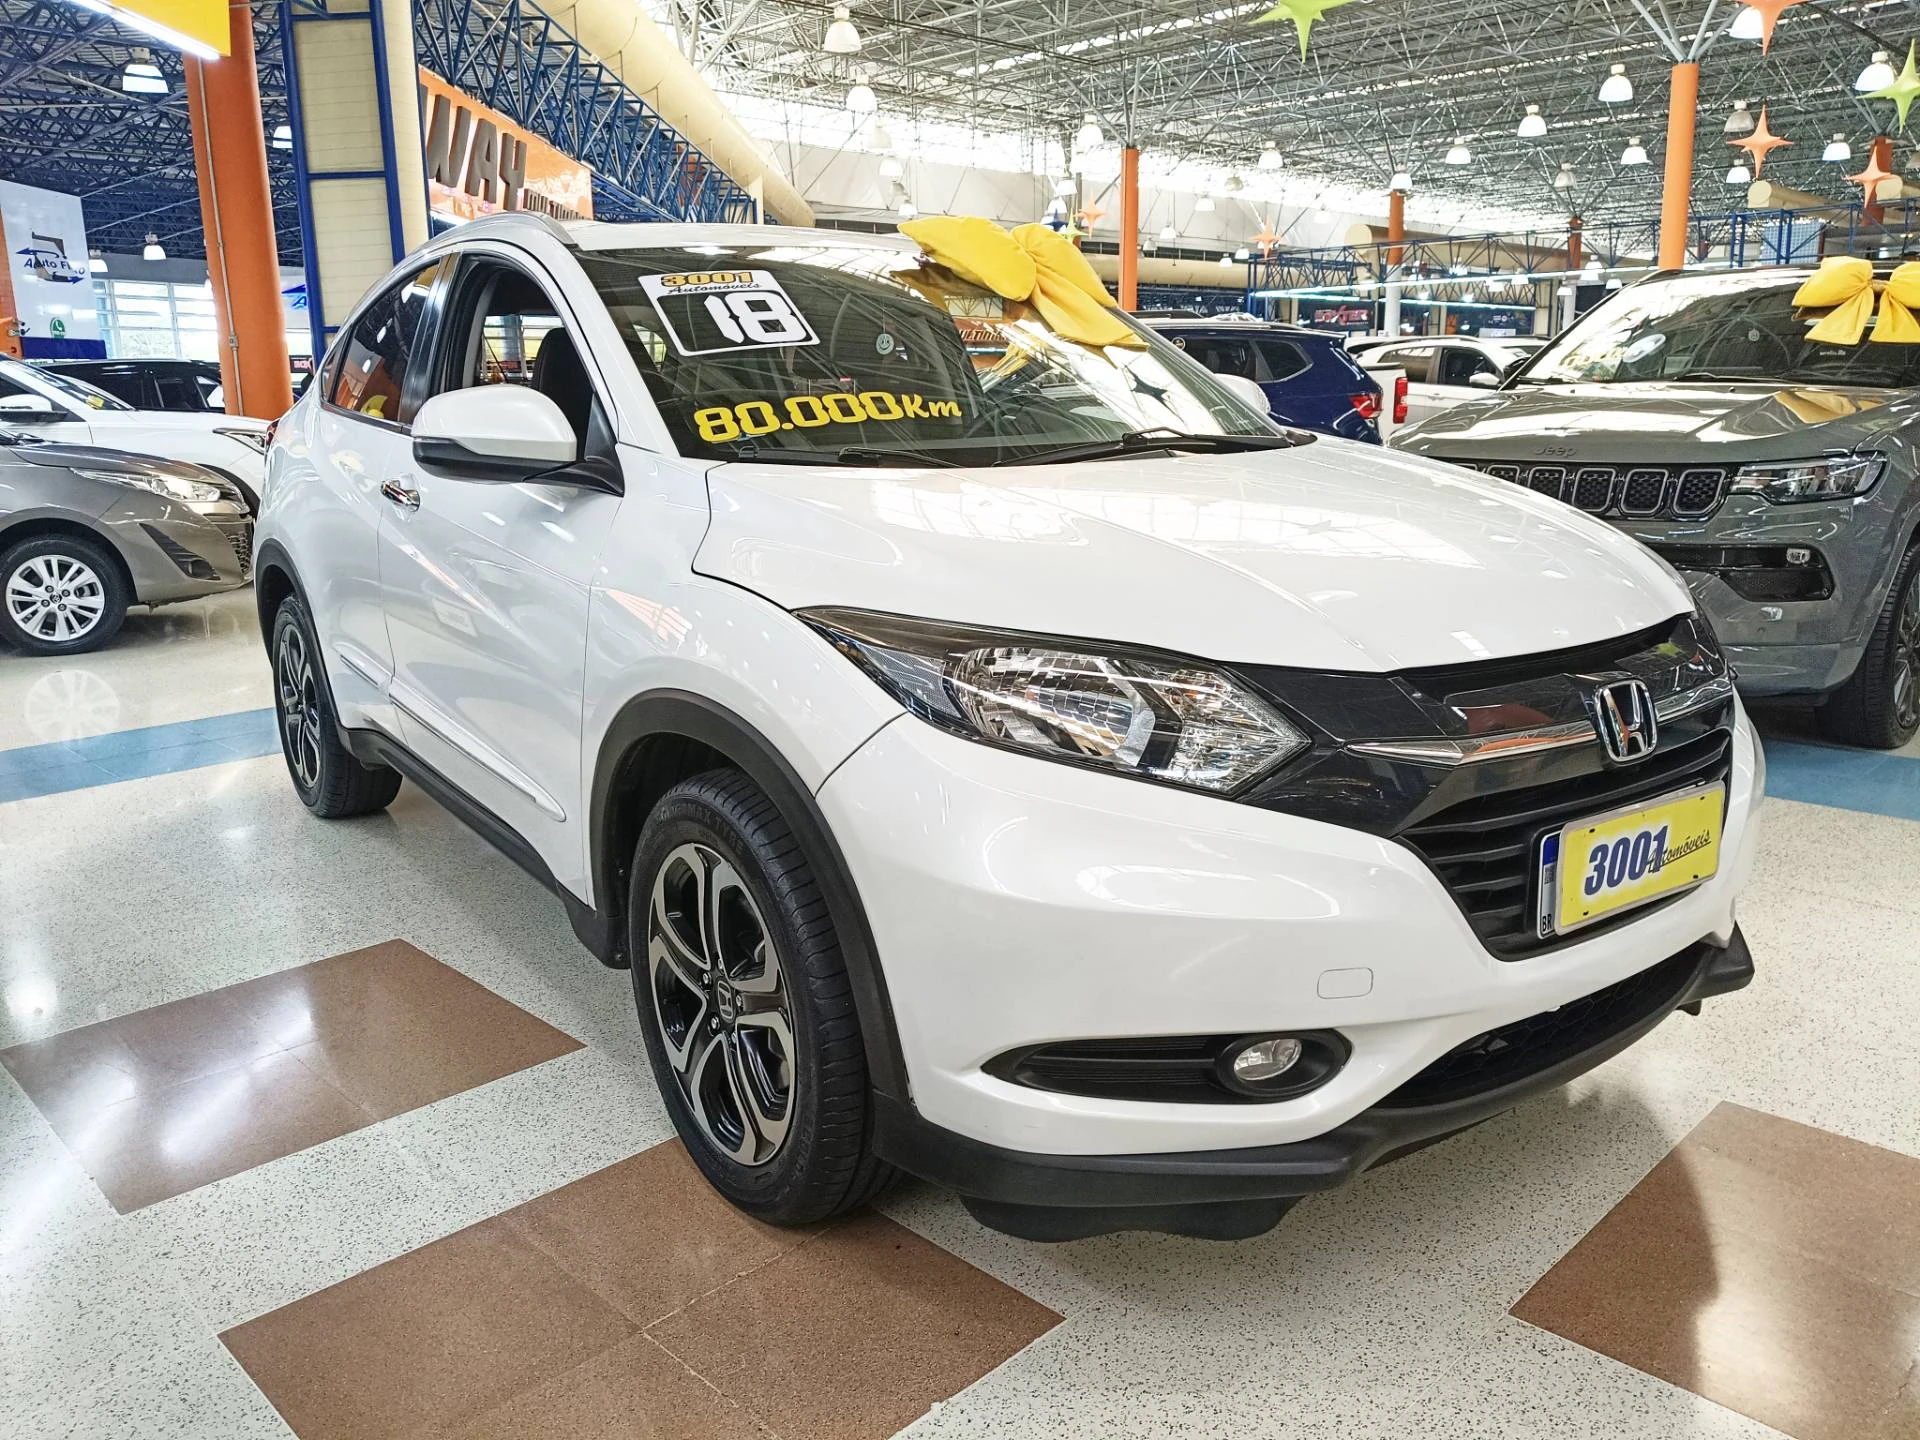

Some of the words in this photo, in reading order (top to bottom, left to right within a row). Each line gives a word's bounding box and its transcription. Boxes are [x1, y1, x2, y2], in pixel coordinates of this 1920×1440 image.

[660, 271, 754, 288] 3001
[703, 291, 807, 344] 18
[1584, 825, 1668, 896] 3001
[1542, 913, 1553, 932] BR
